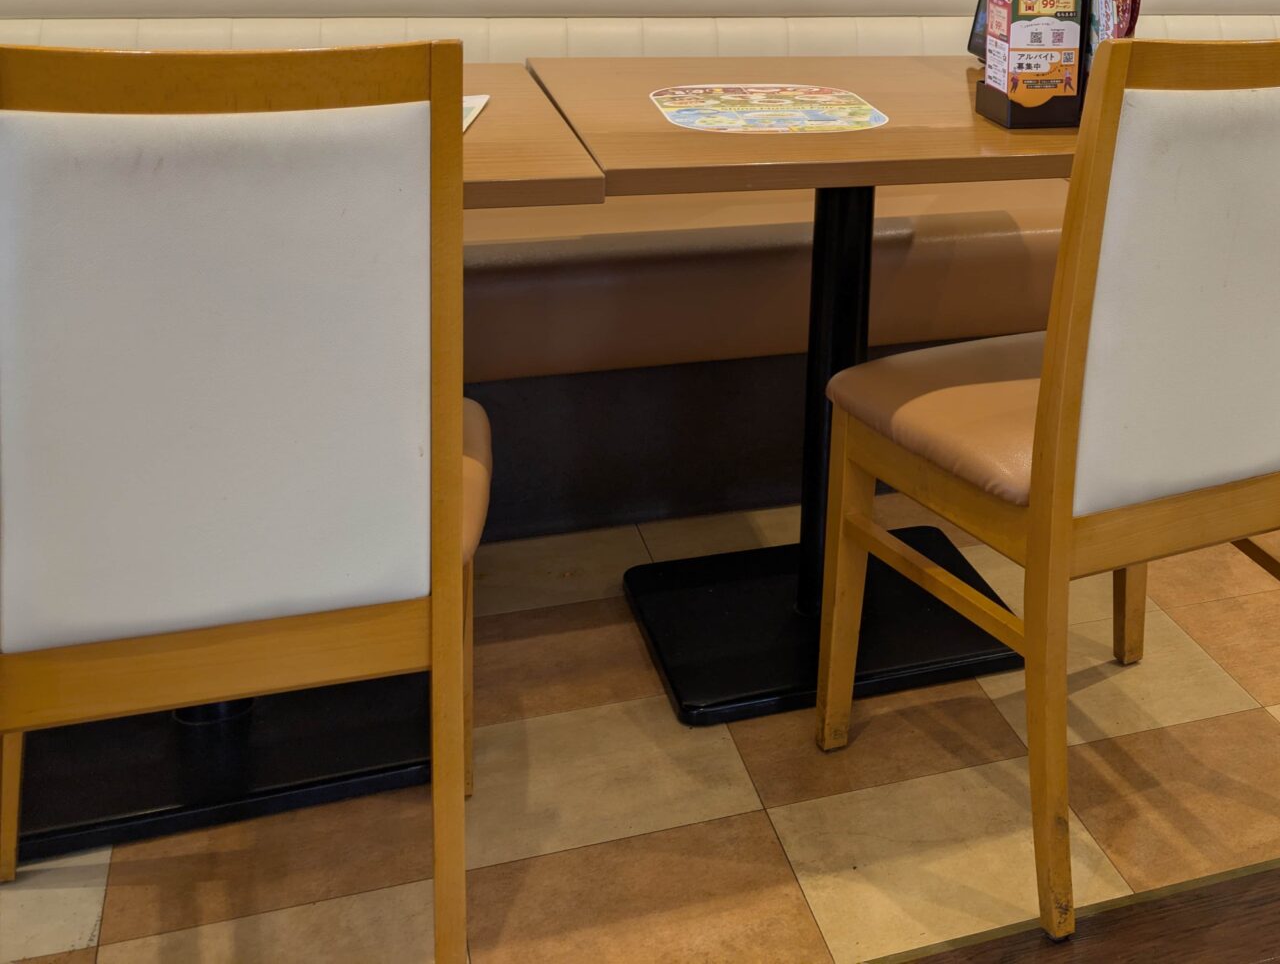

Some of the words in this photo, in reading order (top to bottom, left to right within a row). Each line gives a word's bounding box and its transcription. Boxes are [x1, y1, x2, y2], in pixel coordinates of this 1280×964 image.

[1017, 53, 1055, 61] アルバイト
[1016, 62, 1041, 71] 募集中
